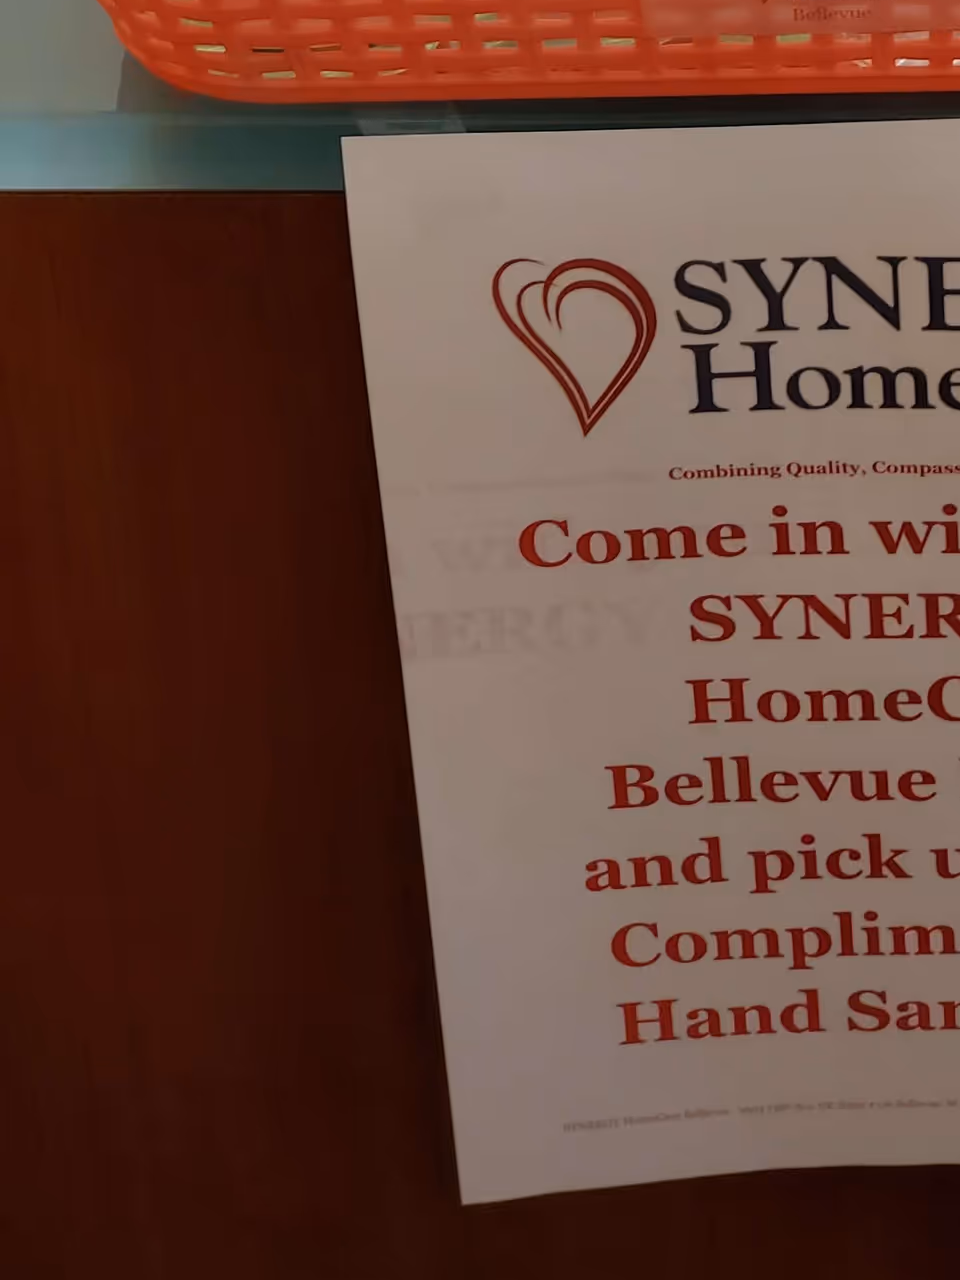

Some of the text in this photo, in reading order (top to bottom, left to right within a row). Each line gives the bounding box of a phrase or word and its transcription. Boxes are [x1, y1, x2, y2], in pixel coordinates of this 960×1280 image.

[669, 462, 782, 483] Combining
[786, 460, 866, 479] Quality,
[518, 519, 747, 568] Come
[769, 505, 850, 557] in
[604, 755, 938, 810] Bellevue
[584, 835, 729, 892] and
[747, 832, 913, 894] pick
[616, 987, 827, 1046] Hand
